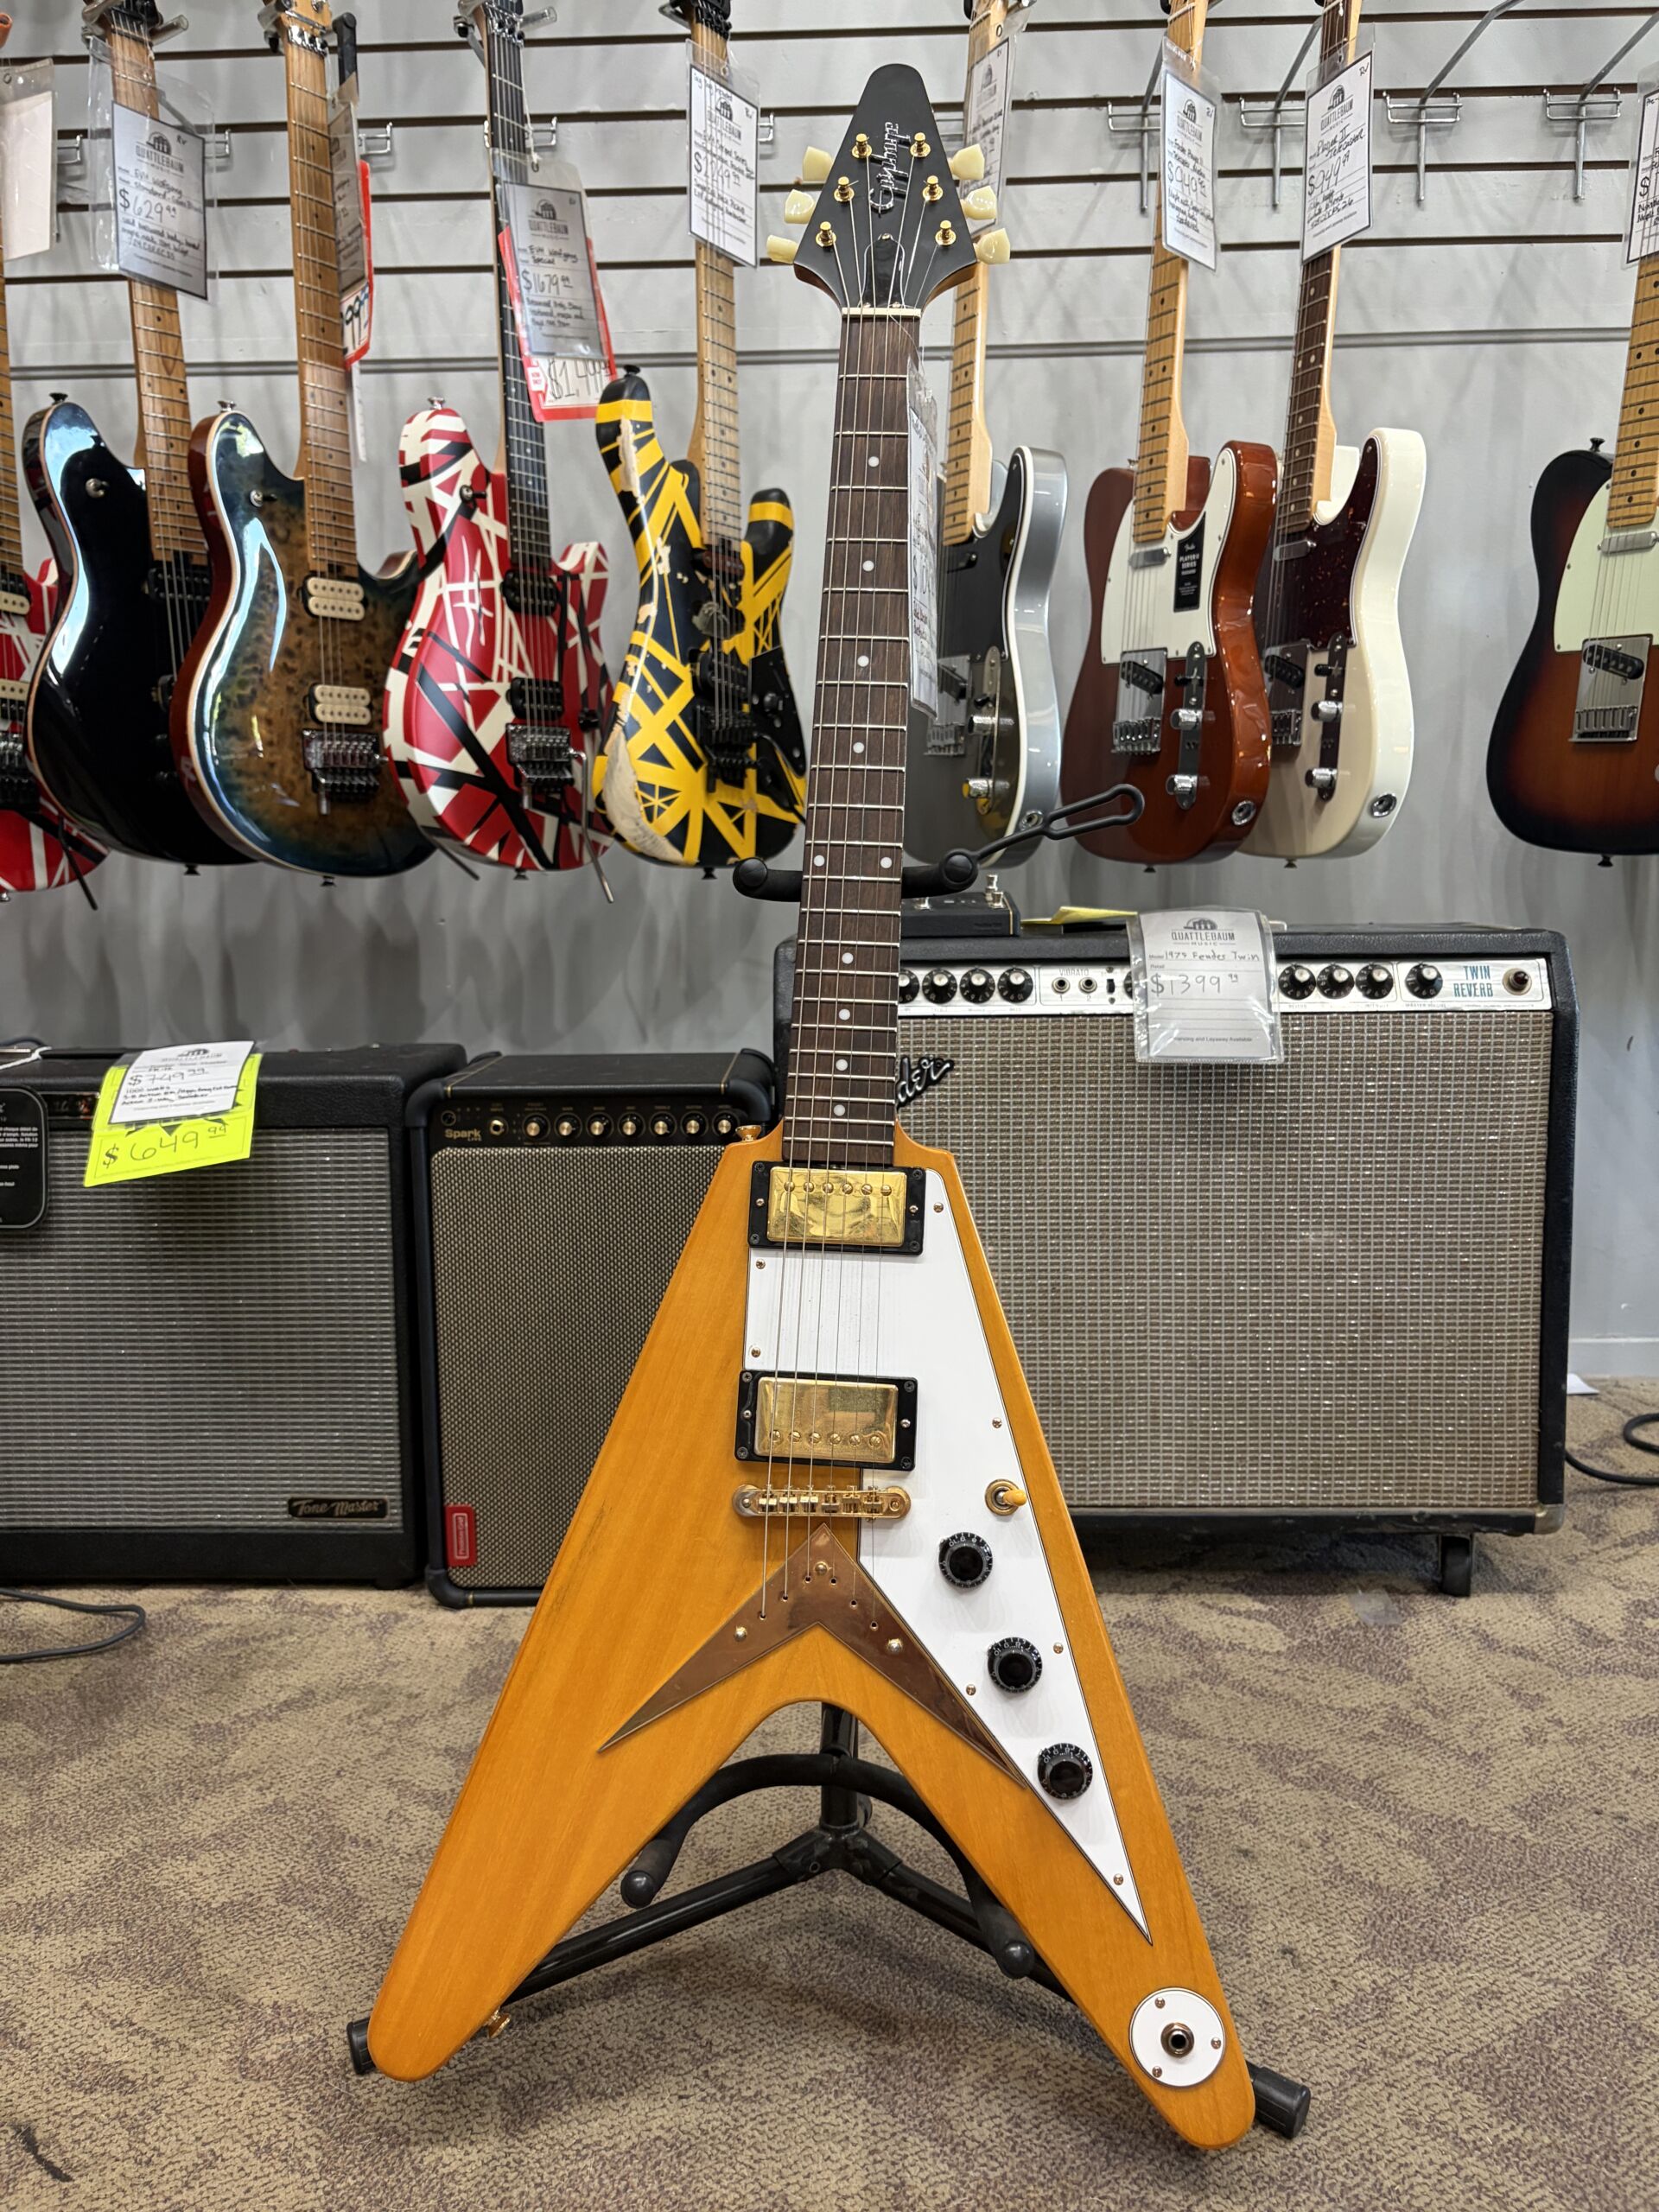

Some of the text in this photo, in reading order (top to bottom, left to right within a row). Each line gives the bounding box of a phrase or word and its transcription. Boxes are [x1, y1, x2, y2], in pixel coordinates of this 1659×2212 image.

[1320, 98, 1352, 130] QUATTLEBAUM
[868, 121, 912, 218] Epiphone
[1179, 554, 1196, 563] PLAYER
[1171, 931, 1236, 941] QUATTLEBAUM
[1231, 951, 1260, 961] Twin
[1058, 968, 1090, 976] VIBRATO
[1463, 965, 1491, 980] TWIN
[1453, 982, 1494, 997] REVERB
[897, 1058, 950, 1102] der
[444, 1128, 481, 1140] Spark
[102, 1125, 227, 1169] $649 99
[292, 1499, 379, 1517] Tone Master
